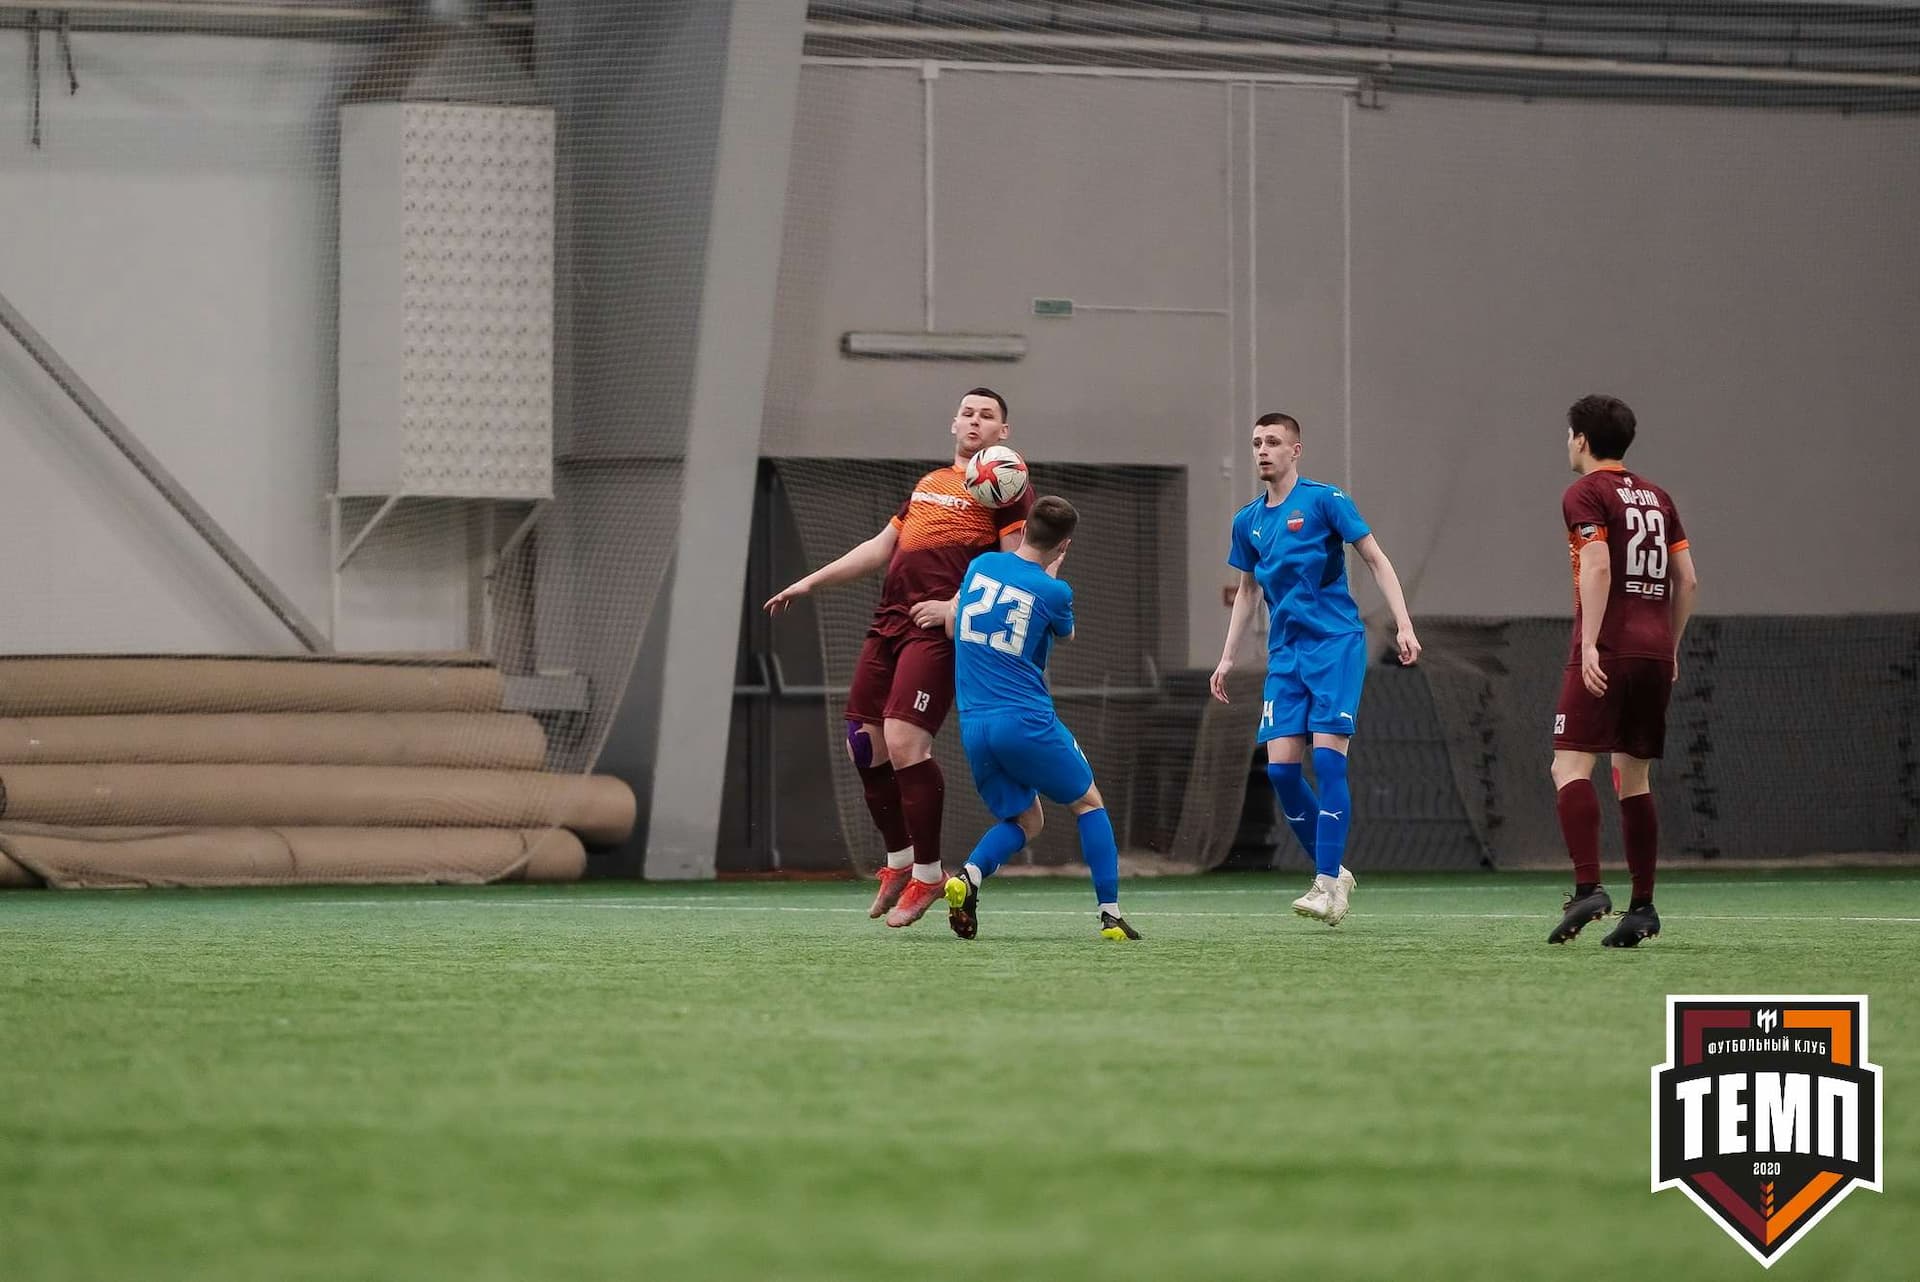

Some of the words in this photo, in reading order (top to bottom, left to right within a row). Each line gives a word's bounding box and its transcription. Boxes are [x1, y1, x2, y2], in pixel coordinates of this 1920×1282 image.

[1625, 507, 1667, 579] 23
[960, 572, 1035, 656] 23
[913, 690, 930, 712] 13
